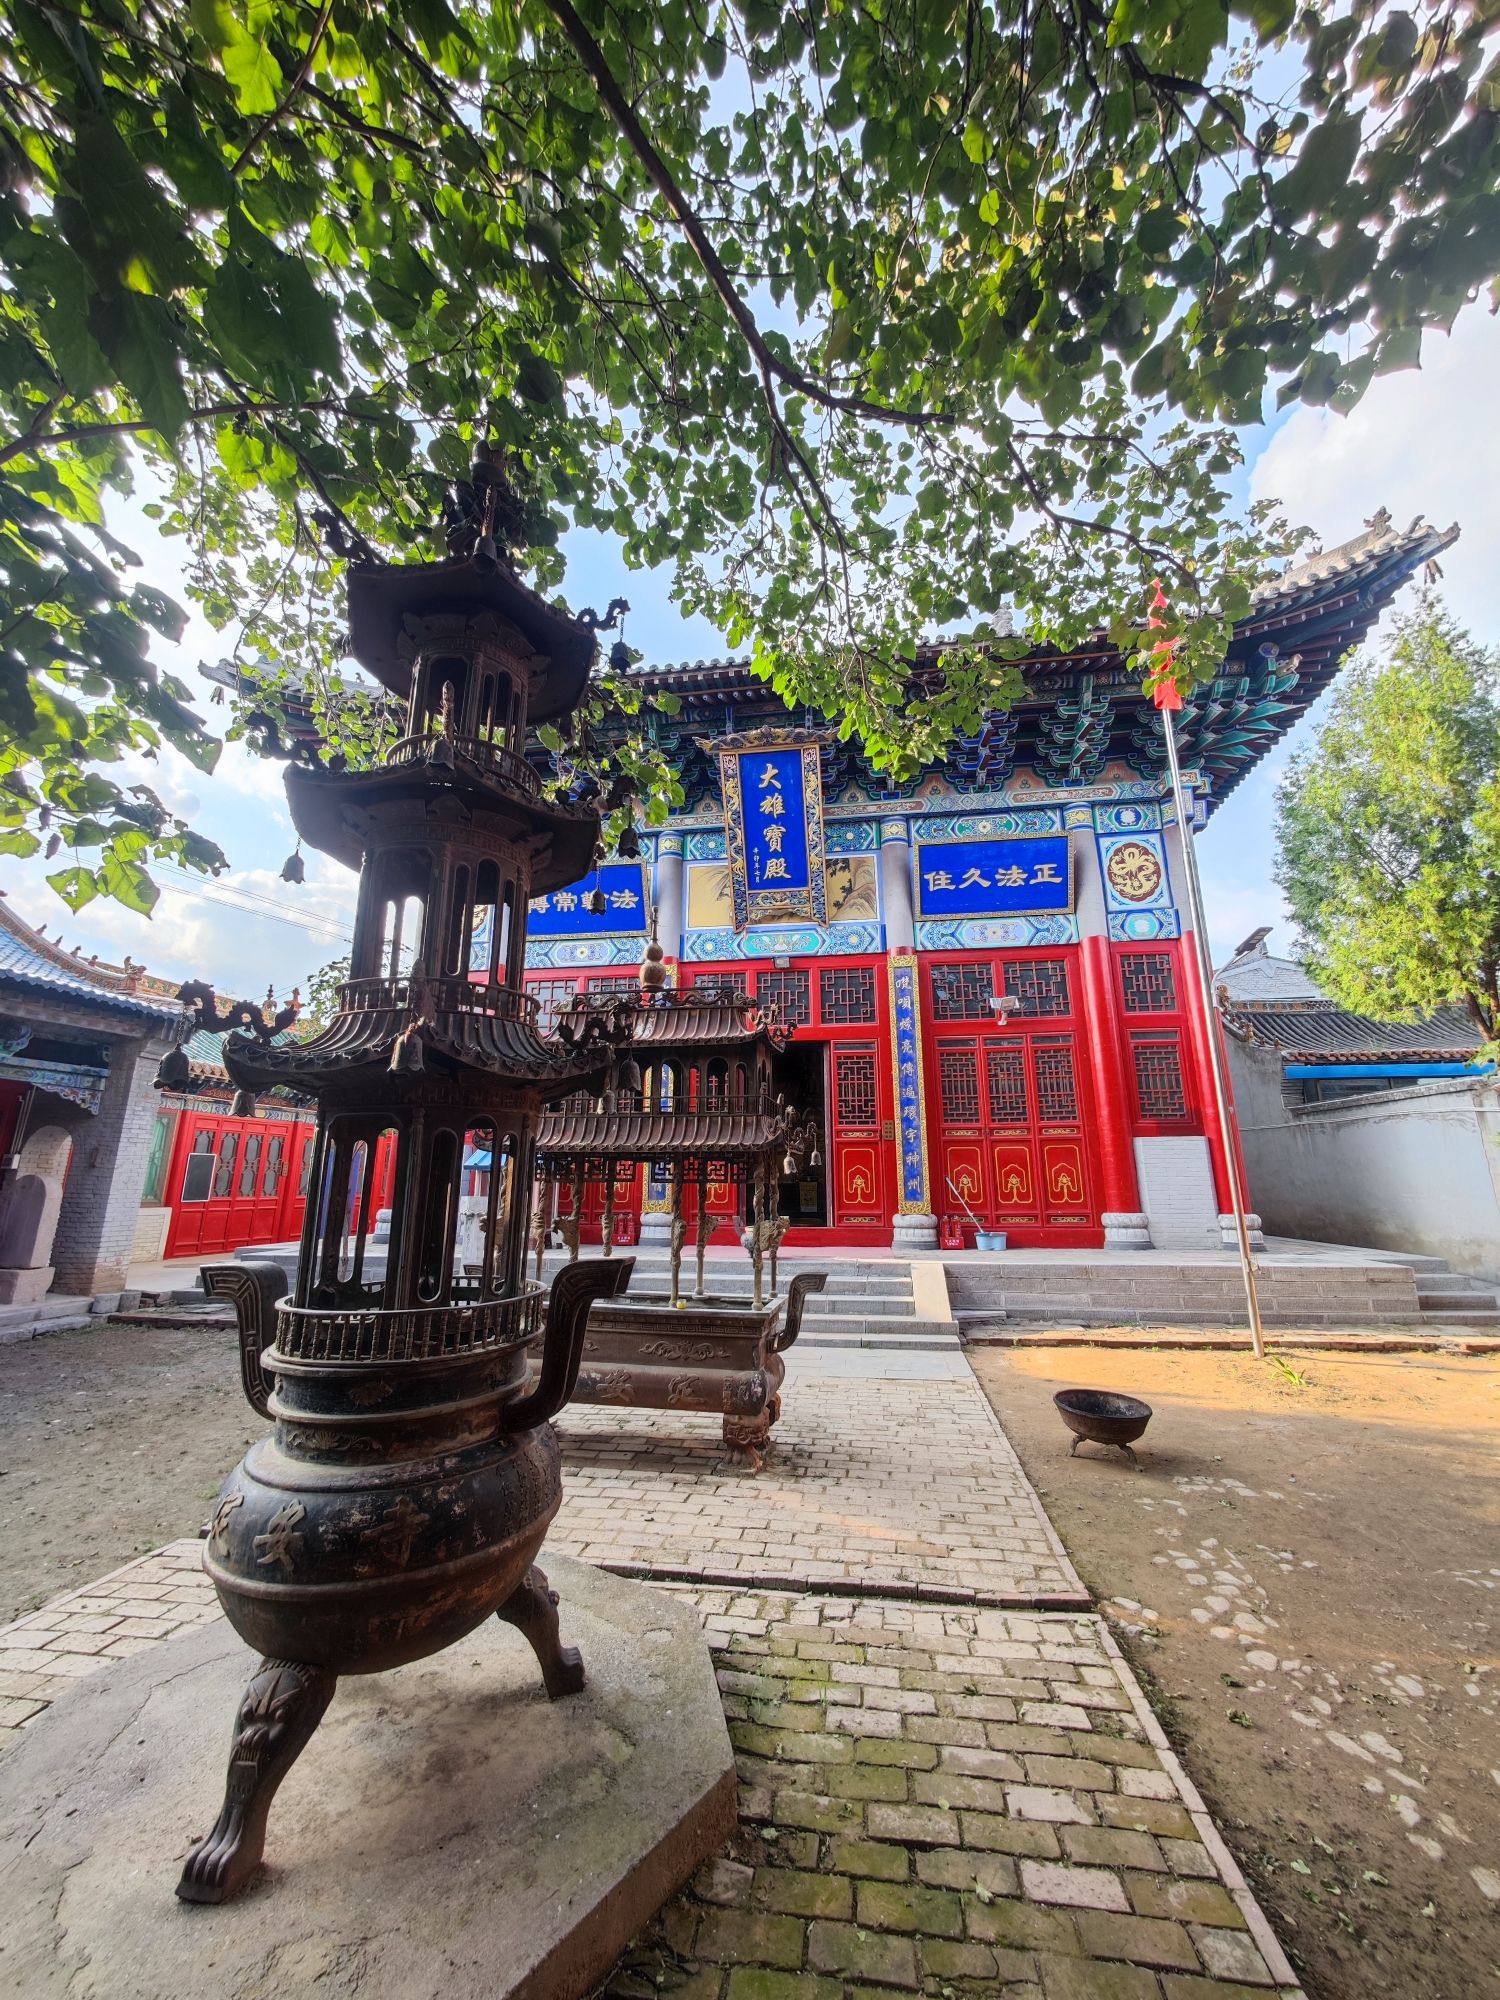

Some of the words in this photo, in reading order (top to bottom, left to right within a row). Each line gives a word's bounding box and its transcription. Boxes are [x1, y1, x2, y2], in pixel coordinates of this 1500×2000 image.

[759, 763, 792, 880] 大雄寶殿
[924, 863, 1063, 893] 正法久住
